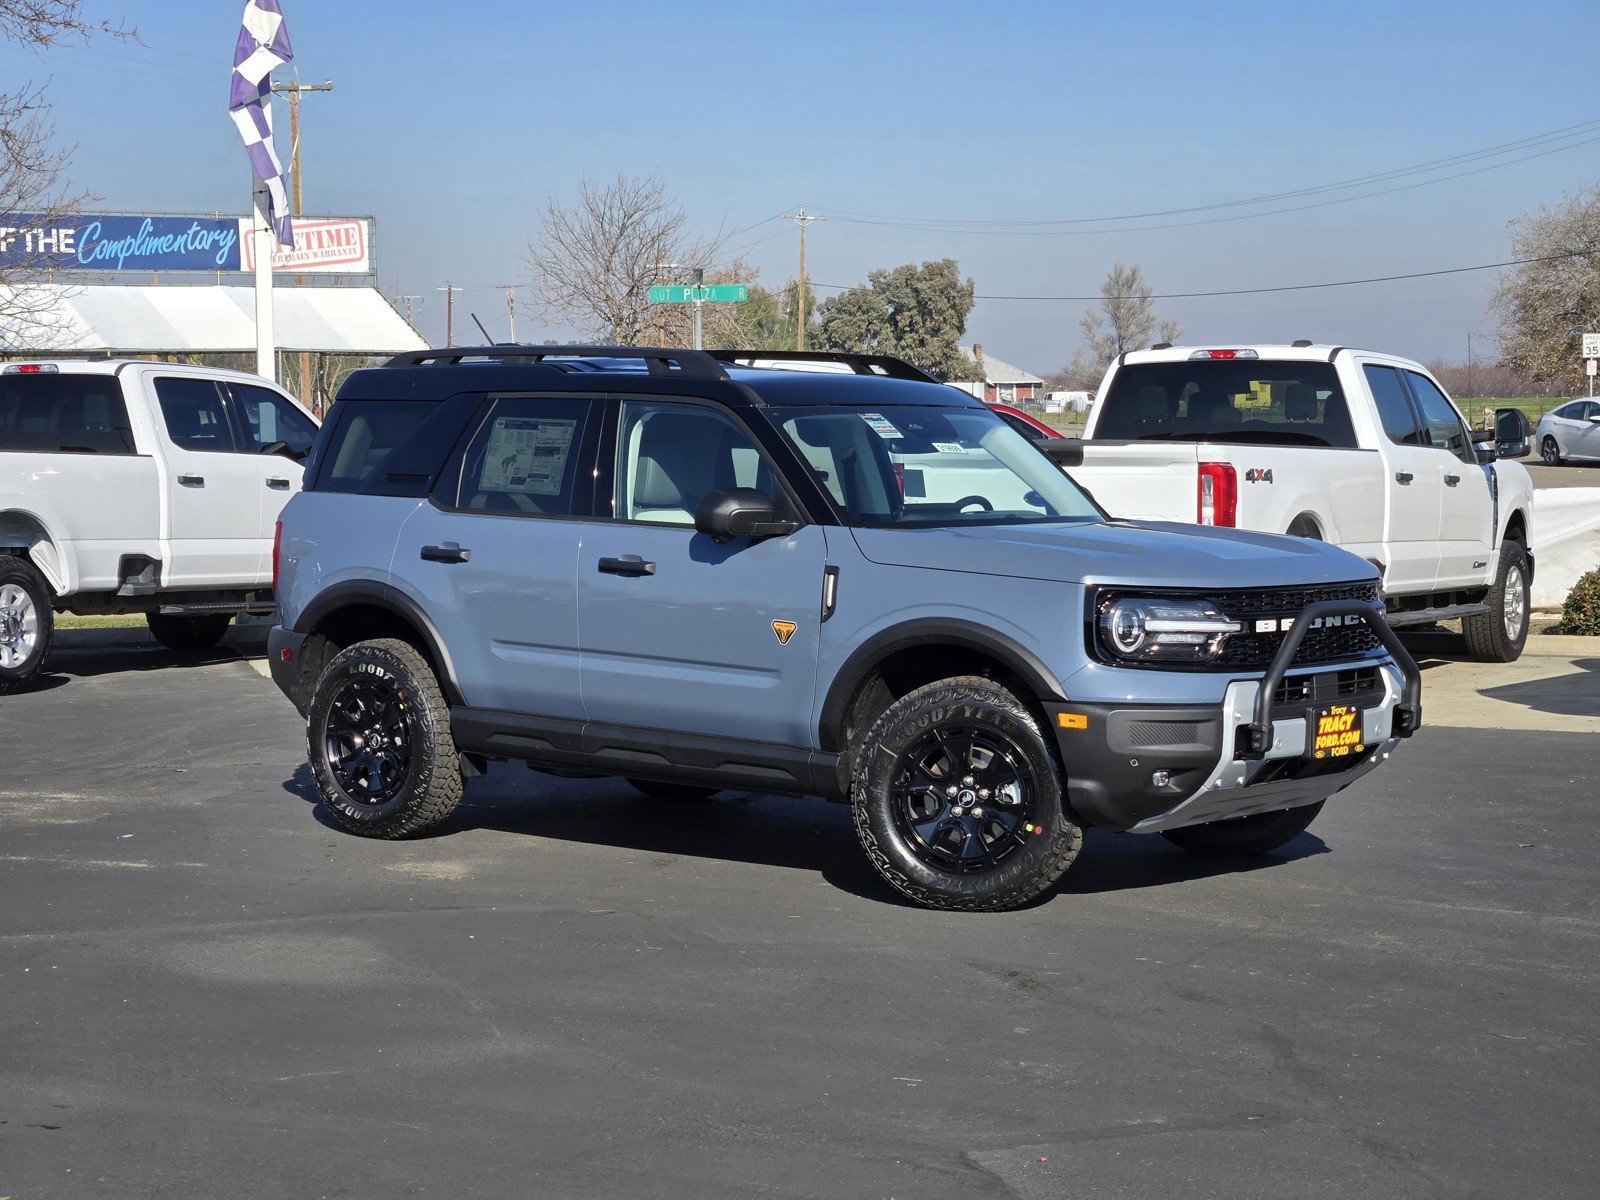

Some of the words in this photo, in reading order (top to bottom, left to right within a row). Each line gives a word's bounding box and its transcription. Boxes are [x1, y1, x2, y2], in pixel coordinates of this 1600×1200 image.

[19, 228, 76, 253] THE
[77, 218, 237, 270] Complimentary
[312, 247, 358, 260] WARRANTY
[1585, 347, 1599, 355] 35
[1331, 706, 1348, 716] Tracy
[1318, 713, 1356, 735] TRACY
[1315, 730, 1361, 750] FORD.COM
[1331, 746, 1349, 757] FORD
